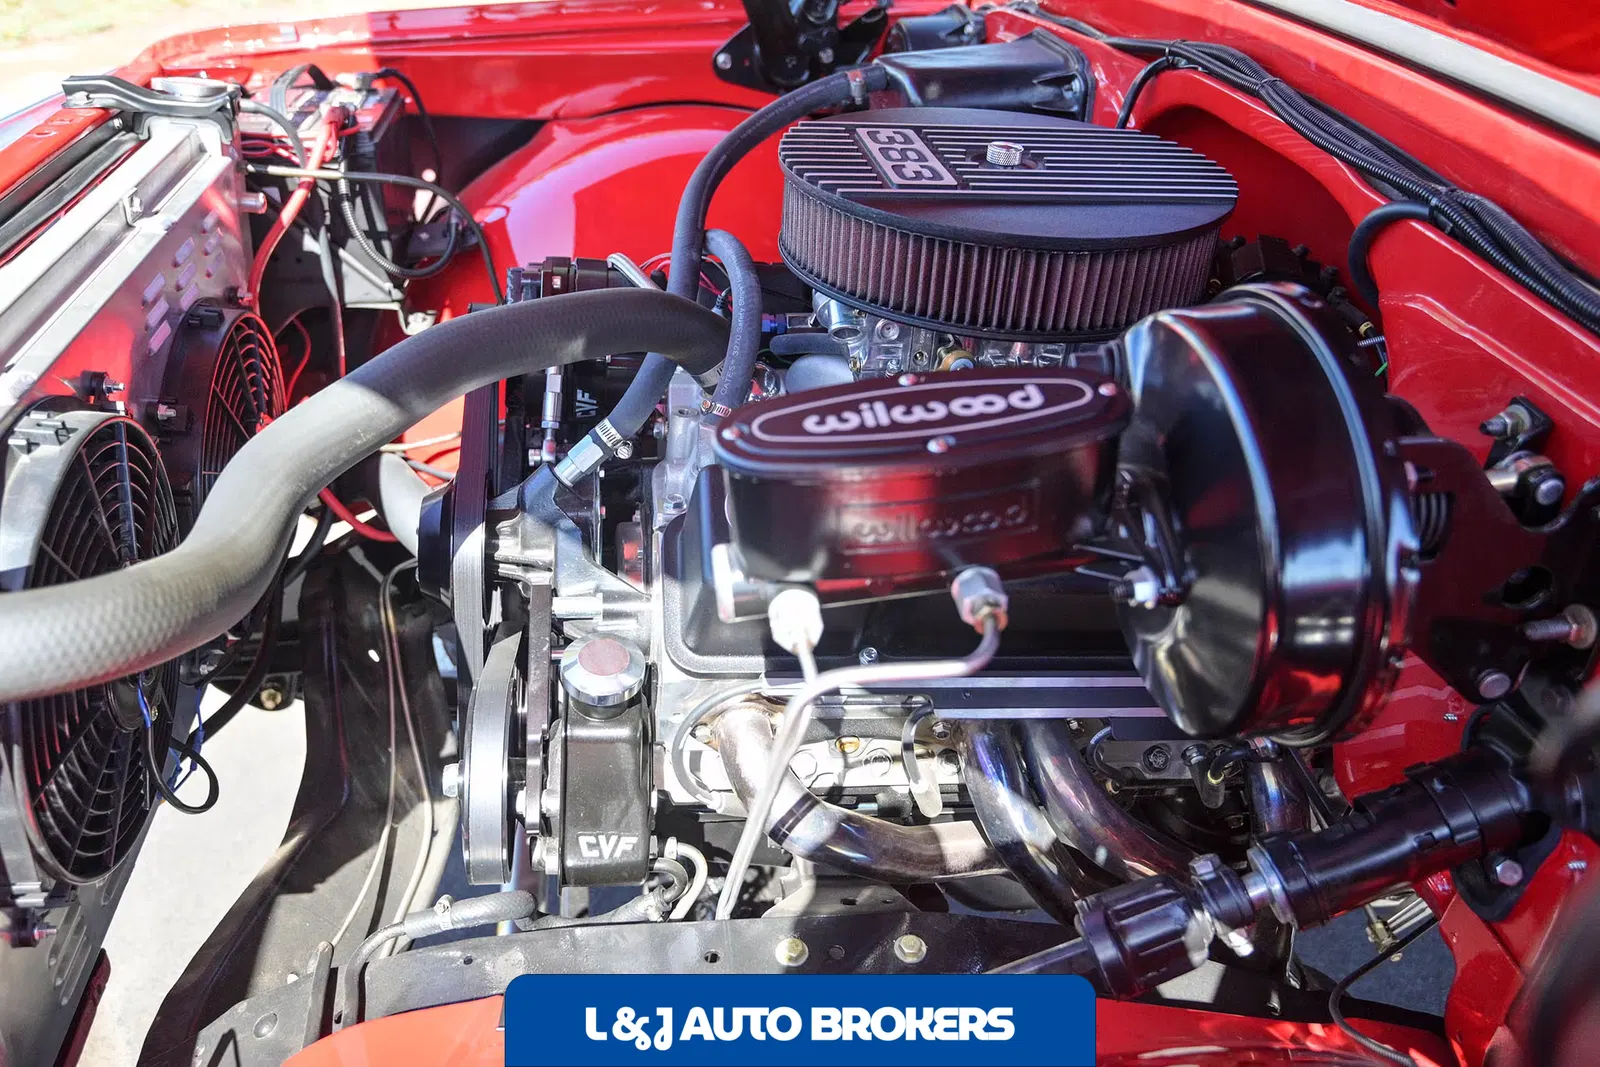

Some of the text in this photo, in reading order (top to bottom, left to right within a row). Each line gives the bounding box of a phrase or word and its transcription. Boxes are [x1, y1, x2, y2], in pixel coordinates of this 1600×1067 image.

[866, 130, 945, 182] 383
[575, 389, 599, 418] CVF
[802, 384, 1045, 434] wilwood
[578, 834, 639, 860] CVF
